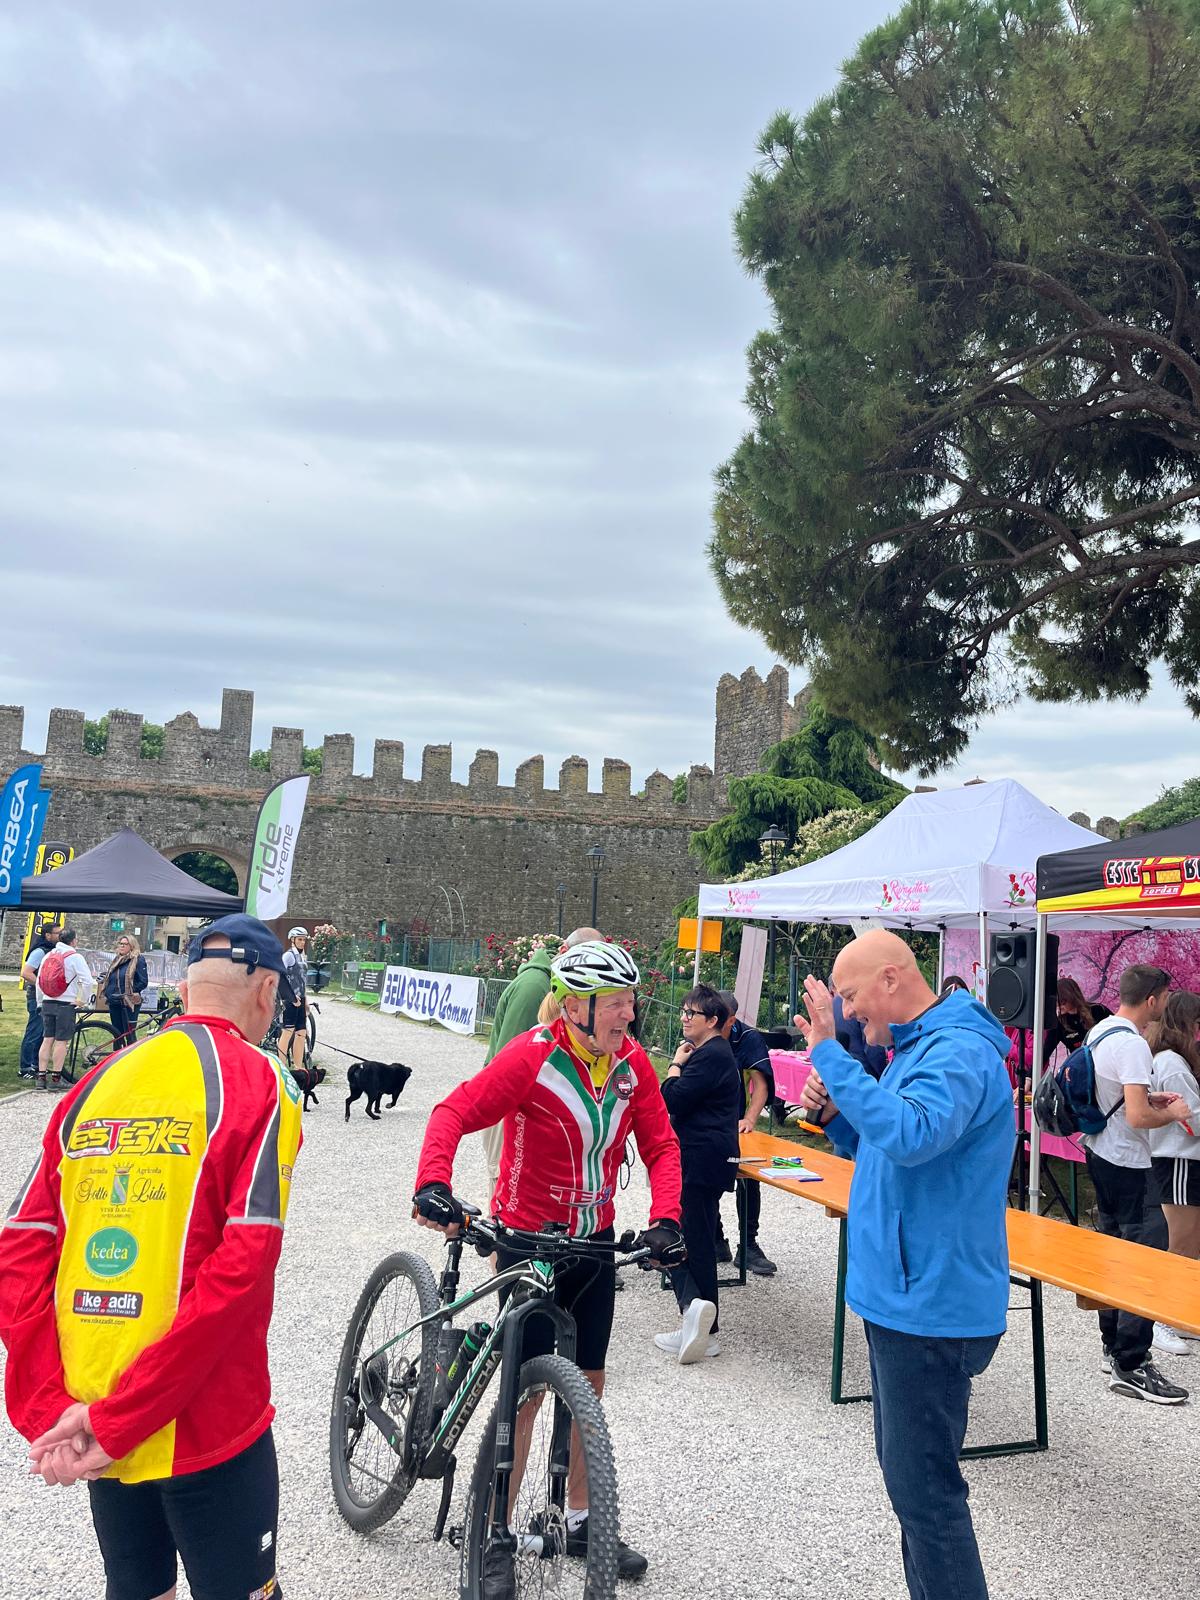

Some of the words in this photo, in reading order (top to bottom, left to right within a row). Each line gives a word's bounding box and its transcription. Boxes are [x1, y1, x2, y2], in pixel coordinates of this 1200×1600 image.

[0, 779, 29, 894] ORBEA
[256, 822, 282, 893] ride
[1106, 860, 1141, 885] ESTE
[91, 1241, 129, 1260] kedea
[443, 1350, 503, 1451] BOTTECCHIA
